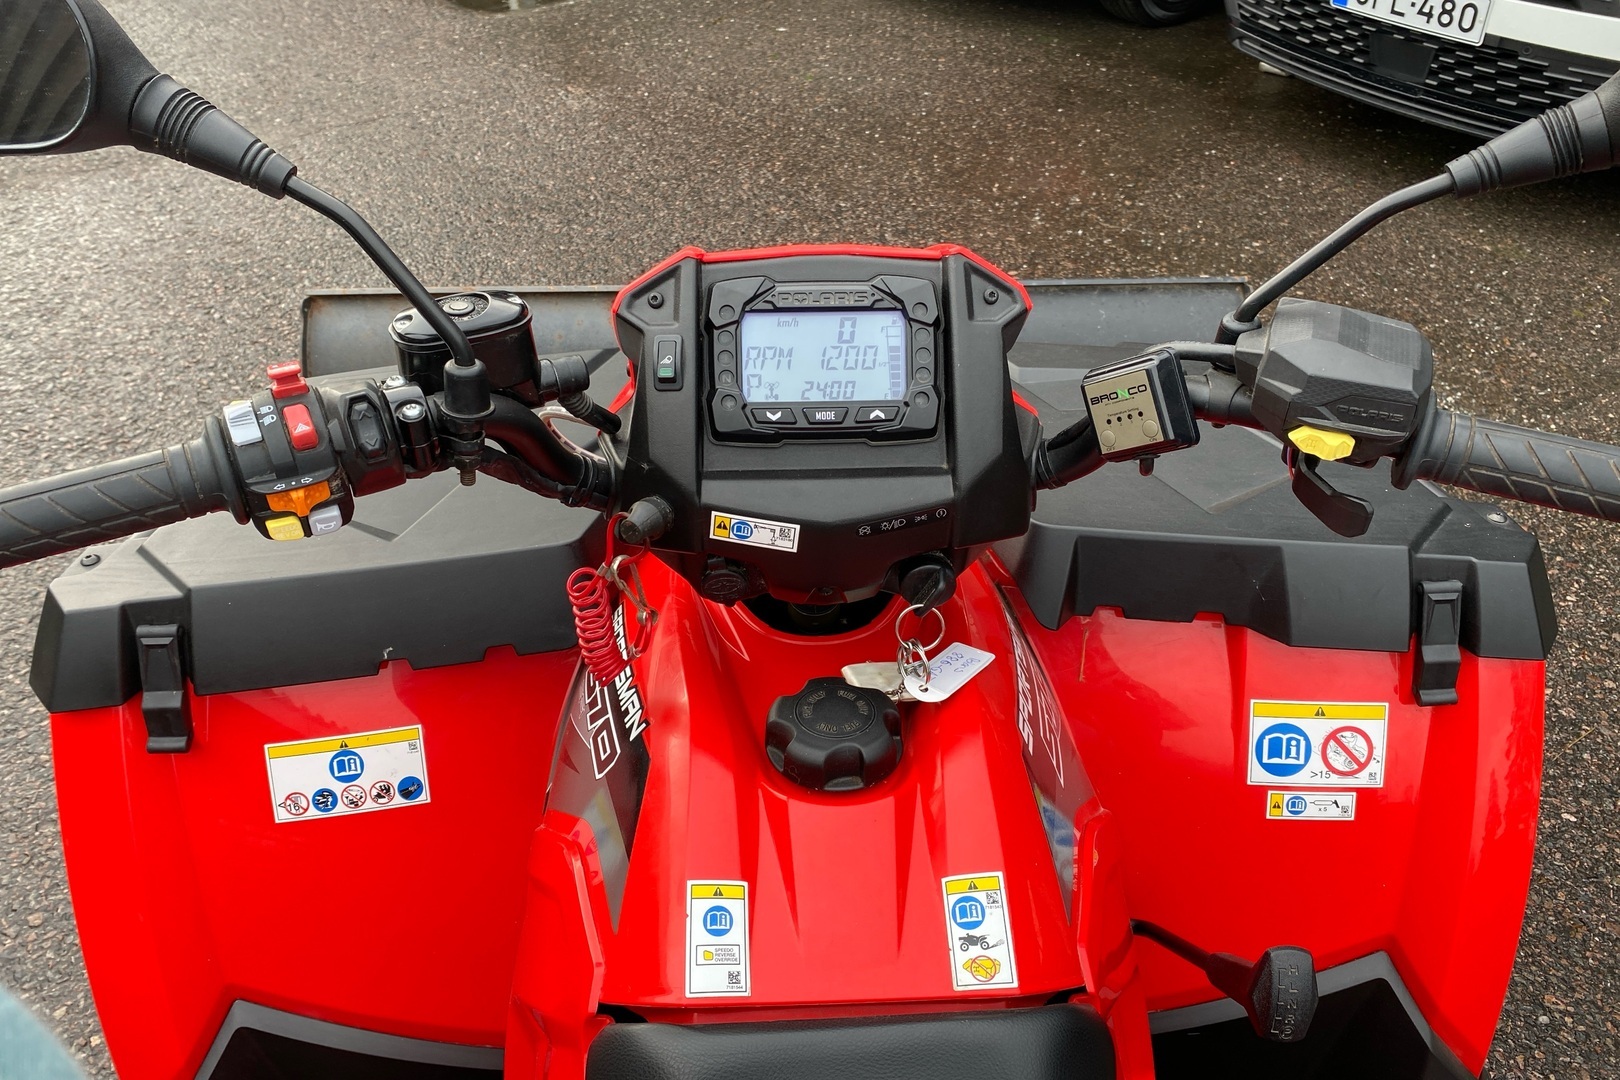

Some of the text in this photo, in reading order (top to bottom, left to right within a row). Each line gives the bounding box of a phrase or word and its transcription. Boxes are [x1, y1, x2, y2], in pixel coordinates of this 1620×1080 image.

[1355, 0, 1478, 33] L-480
[777, 291, 869, 305] POLARIS
[777, 317, 800, 328] km/h
[837, 316, 858, 344] 0
[744, 345, 879, 371] RPM 1200
[746, 373, 762, 400] P
[801, 380, 857, 400] 24:00
[1090, 384, 1148, 405] BRONCO
[815, 411, 836, 421] MODE
[1336, 404, 1404, 423] POLARIS
[837, 690, 857, 701] FUEL
[815, 720, 862, 733] FUEL ONLY
[1288, 964, 1299, 975] H
[1289, 982, 1299, 993] L
[1287, 998, 1297, 1009] N
[1285, 1014, 1295, 1024] R
